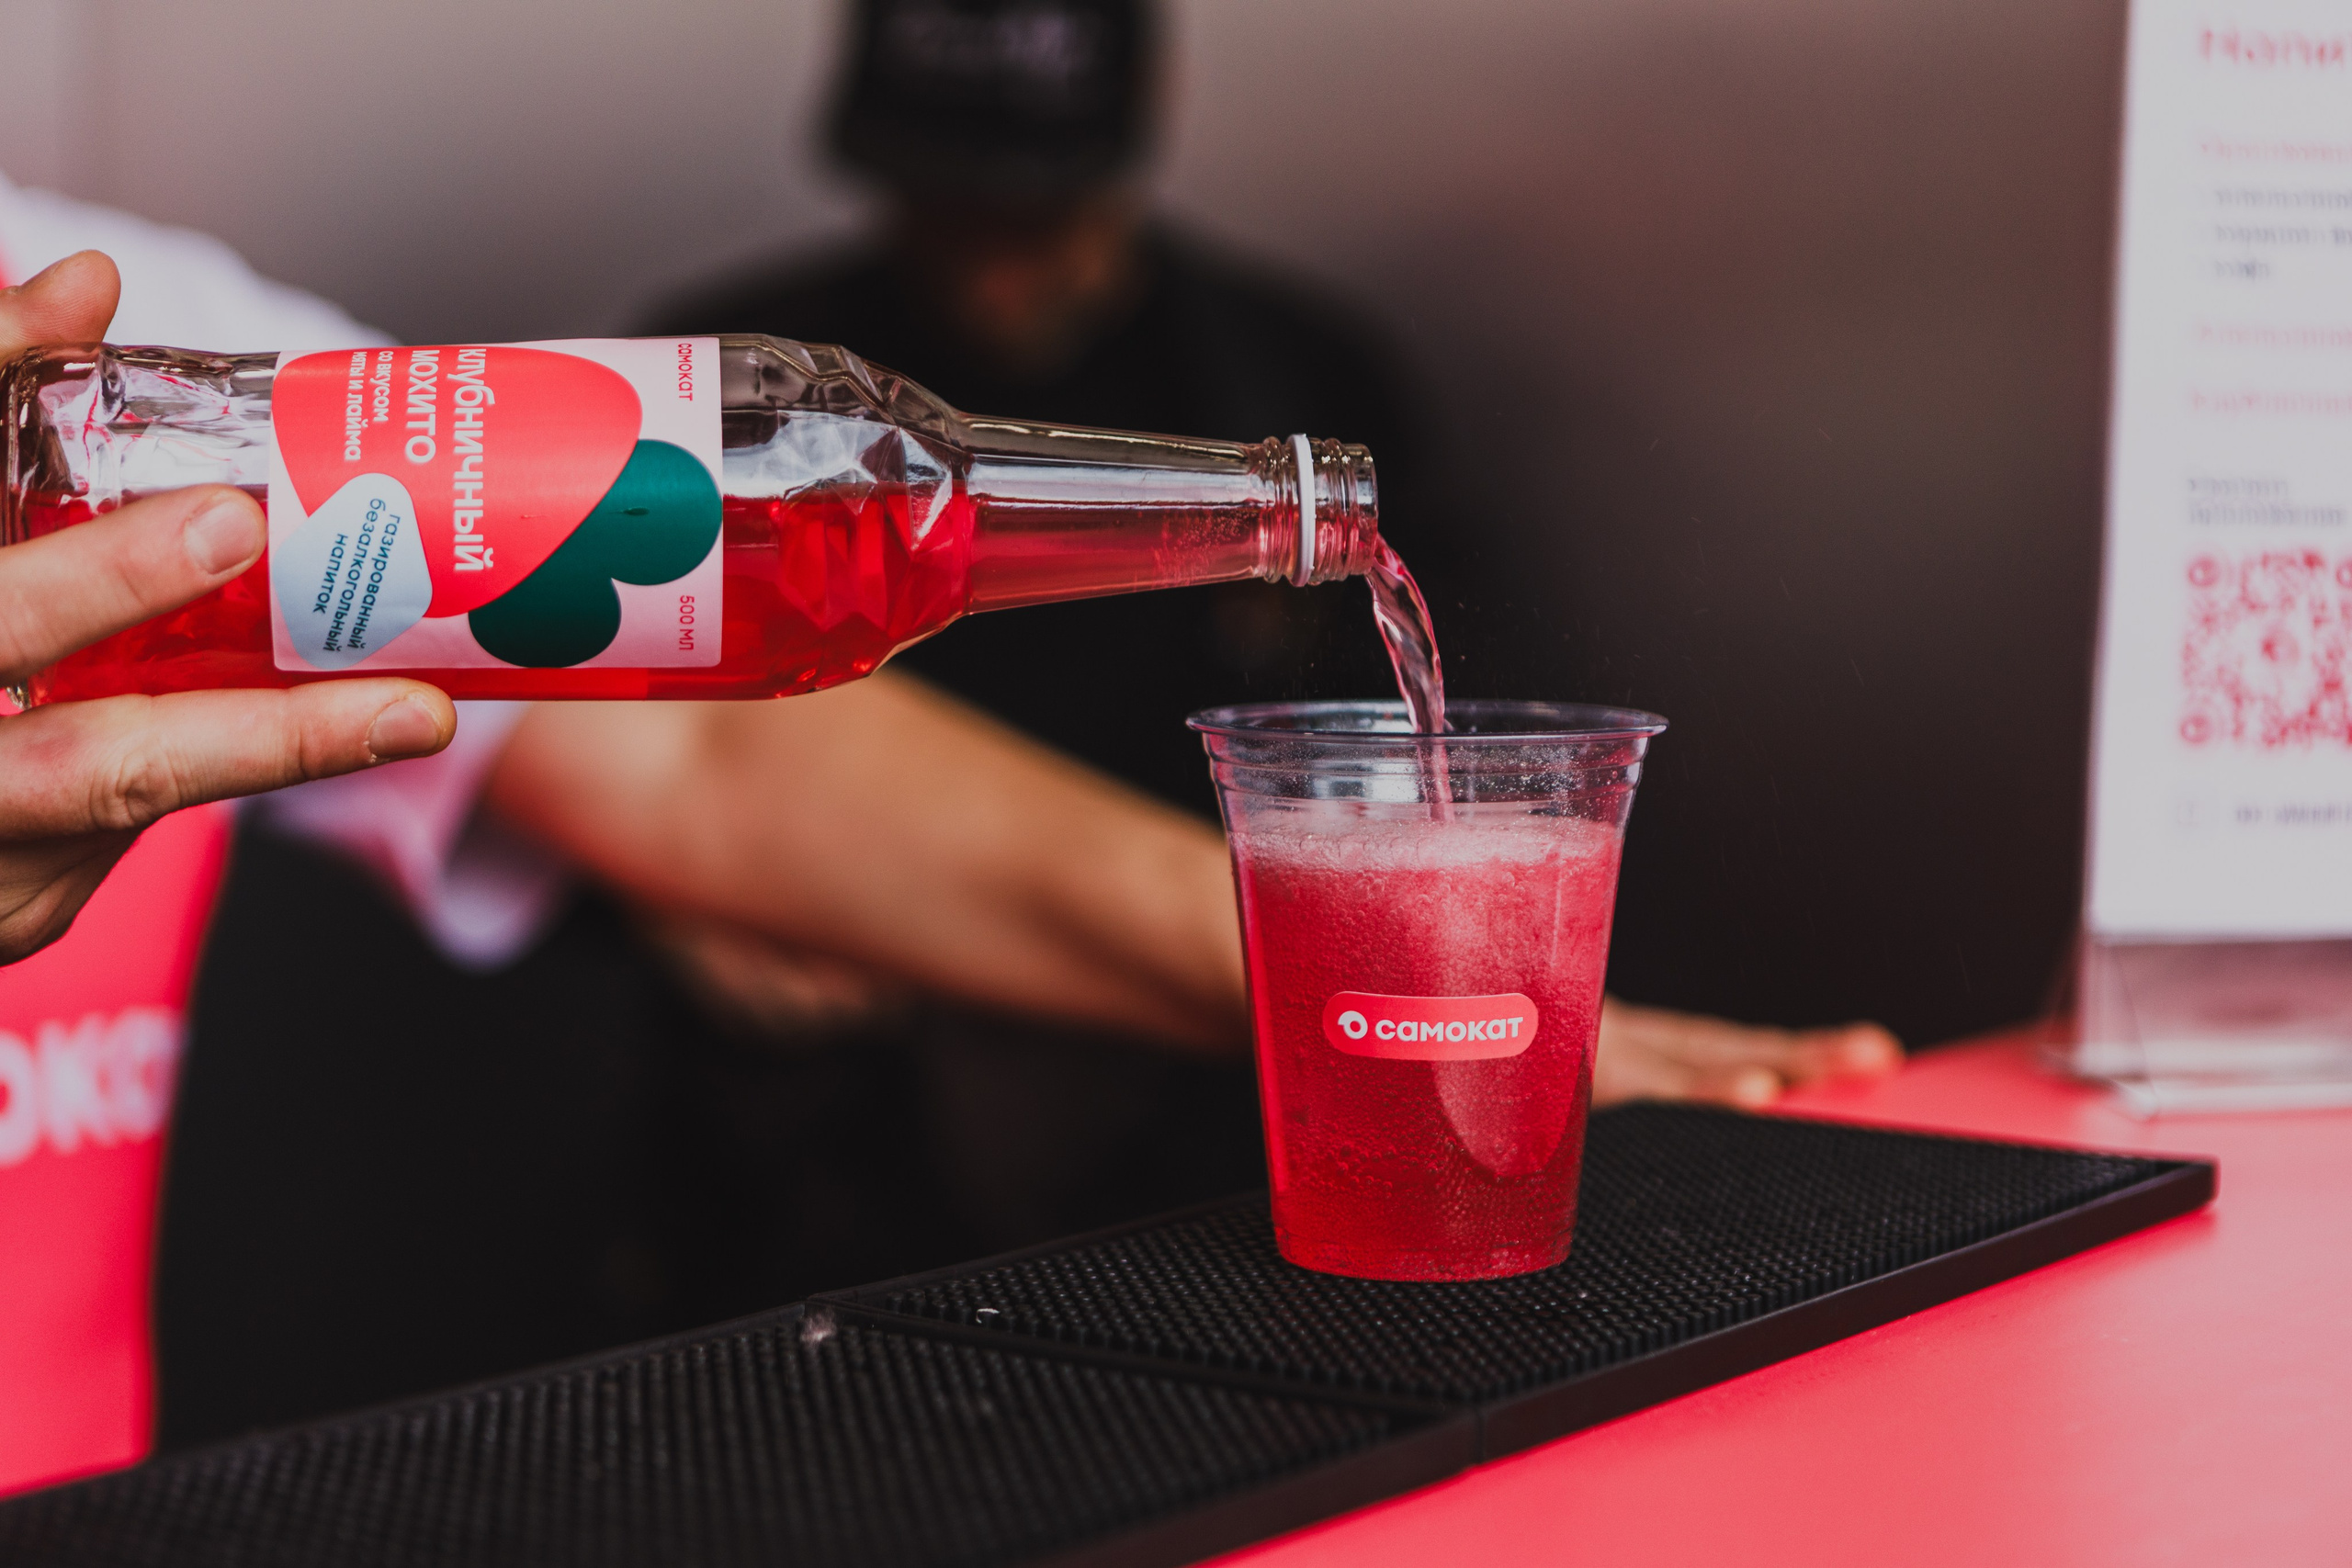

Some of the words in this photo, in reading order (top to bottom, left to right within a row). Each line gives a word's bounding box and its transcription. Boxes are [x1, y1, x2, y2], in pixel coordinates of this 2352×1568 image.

[348, 379, 364, 389] и
[349, 352, 368, 377] мяты
[379, 351, 393, 362] со
[678, 343, 693, 401] самокат
[370, 364, 391, 422] вкусом
[345, 393, 368, 461] лайма
[447, 348, 495, 571] клубничный
[312, 534, 348, 615] напиток
[322, 498, 386, 652] безалкогольный
[347, 513, 401, 649] газированный
[679, 595, 694, 625] 500
[1375, 1017, 1523, 1042] самокат
